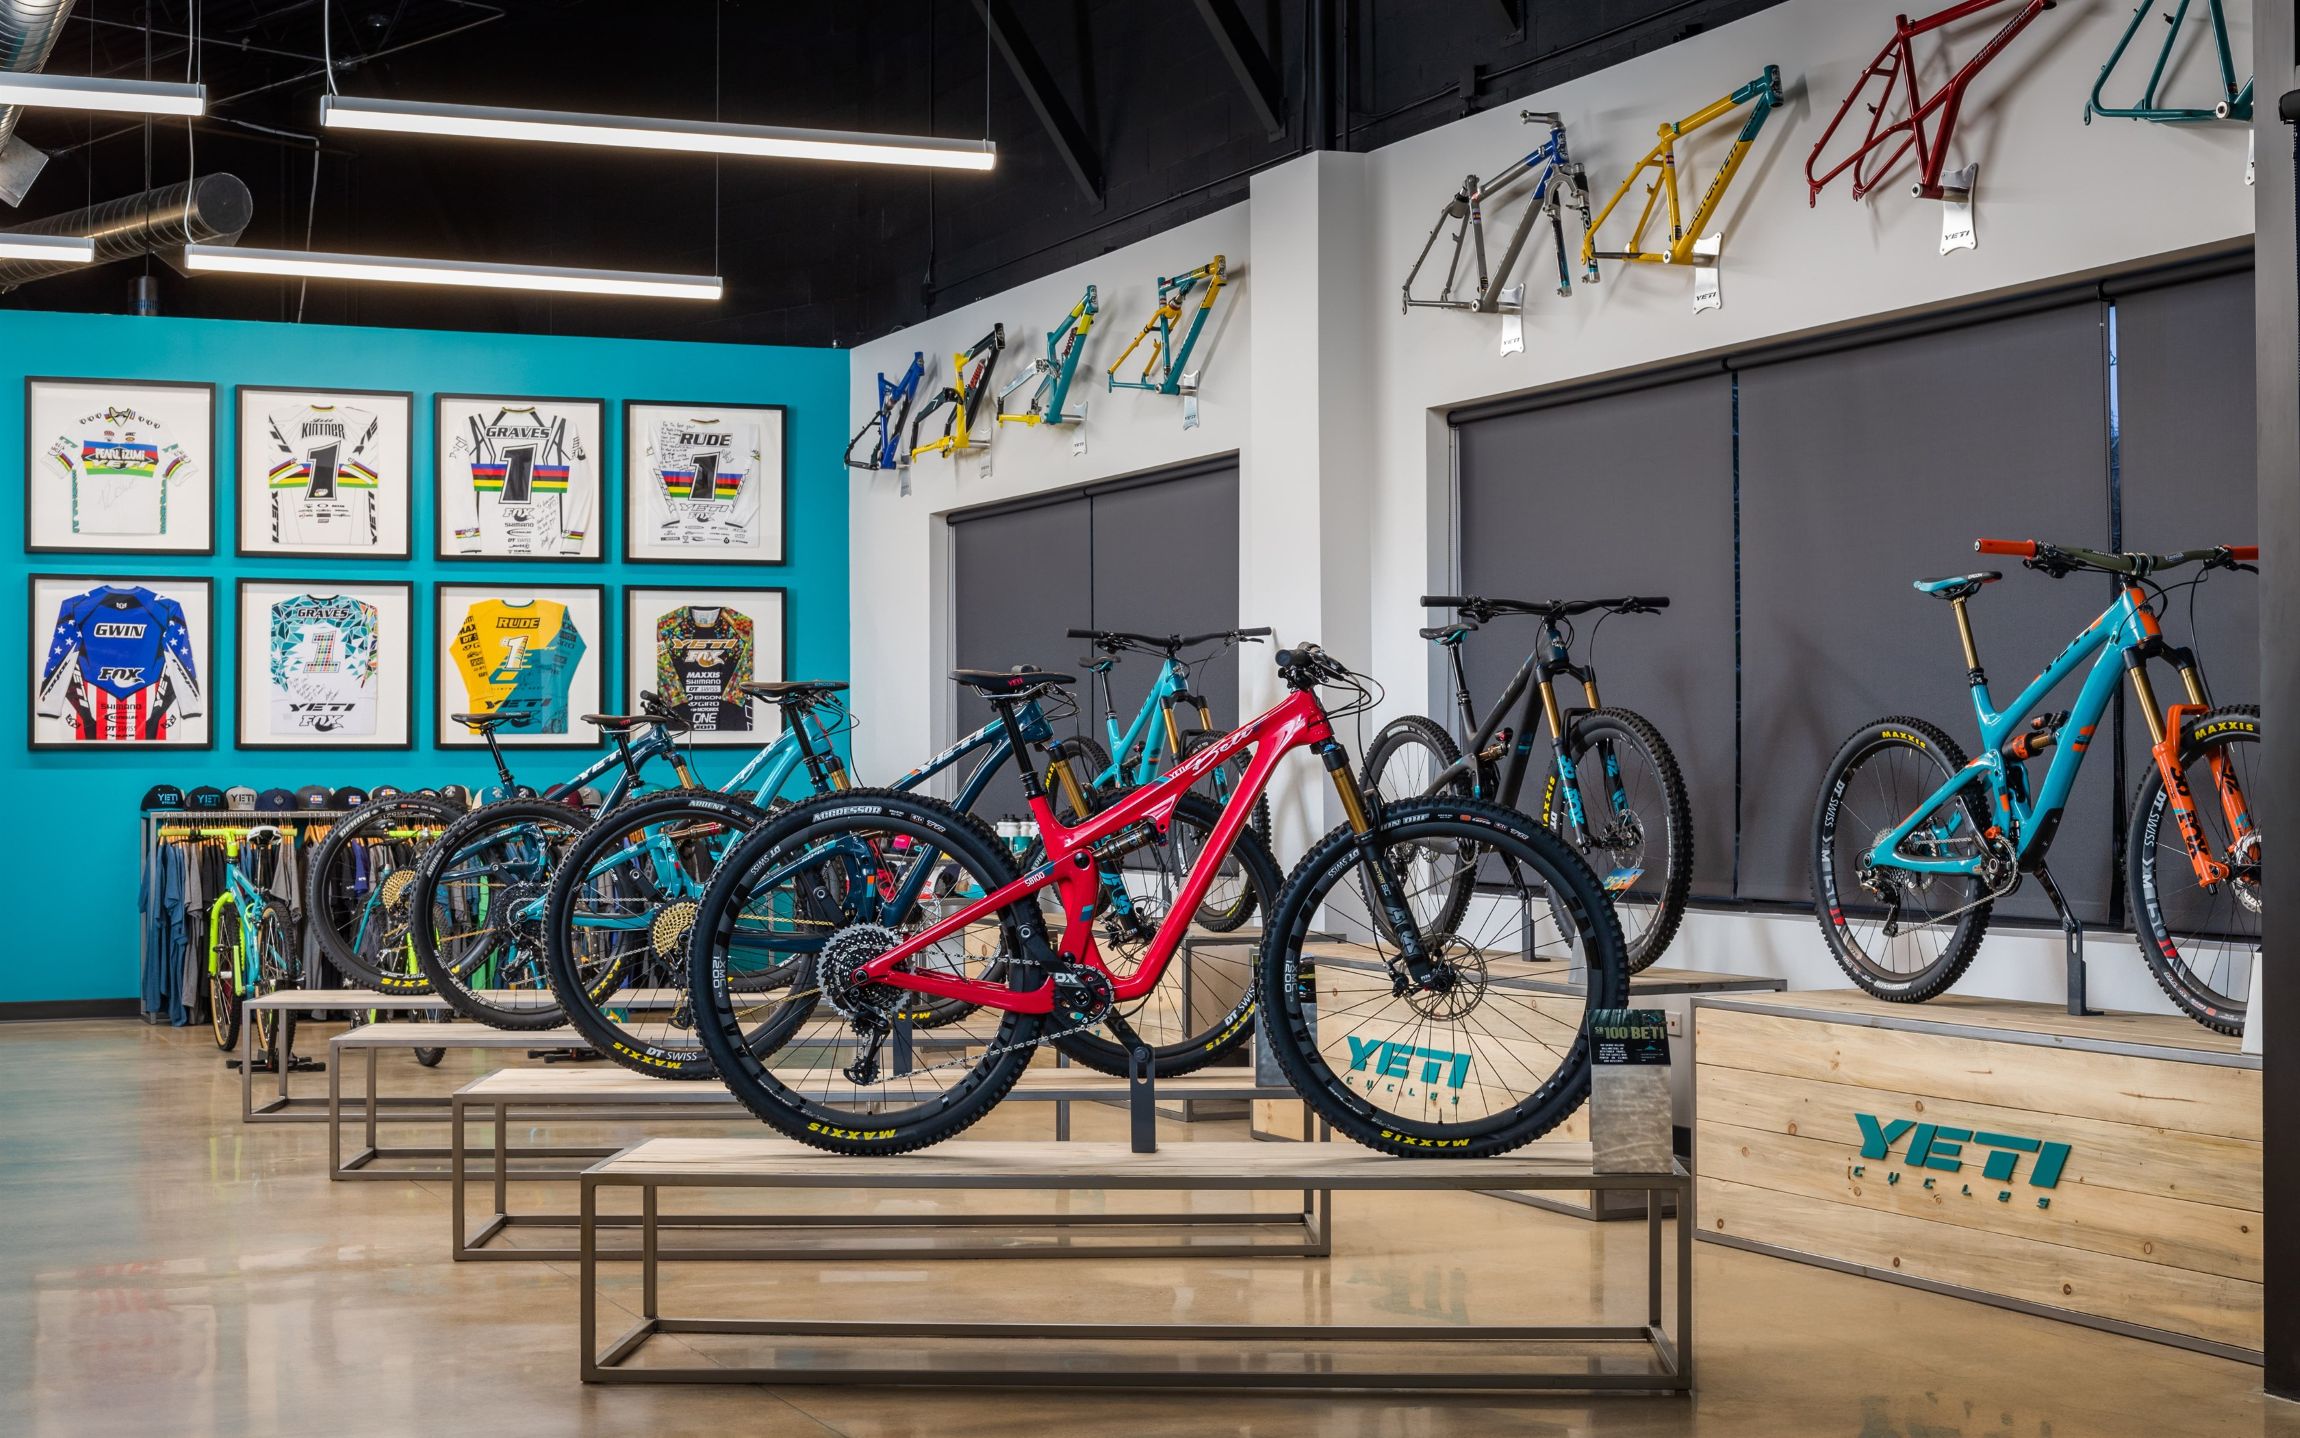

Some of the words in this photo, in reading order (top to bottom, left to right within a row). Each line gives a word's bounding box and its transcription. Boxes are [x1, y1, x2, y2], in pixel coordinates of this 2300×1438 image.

[1945, 229, 1970, 241] YETI
[1695, 290, 1718, 303] YETI
[1503, 337, 1521, 347] YETI
[485, 425, 552, 440] GRAVES
[680, 432, 734, 447] RUDE
[304, 440, 341, 501] 1
[498, 443, 538, 504] 1
[688, 451, 720, 501] 1
[503, 507, 535, 522] FOX
[688, 512, 716, 523] FOX
[297, 608, 350, 618] GRAVES
[95, 624, 146, 638] GWIN
[496, 616, 541, 629] RUDE
[672, 639, 739, 649] YETI
[503, 635, 529, 671] 1
[685, 650, 725, 667] FOX
[98, 667, 145, 688] FOX
[289, 703, 355, 712] YETI
[299, 715, 344, 732] FOX
[2194, 721, 2254, 740] MAXXIS
[1882, 730, 1926, 749] MAXXIS
[1169, 766, 1187, 779] YETI
[1835, 779, 1845, 798] DT
[157, 793, 179, 802] YETI
[196, 794, 220, 803] YETI
[230, 794, 255, 803] YETI
[2157, 790, 2167, 811] DT
[812, 805, 882, 823] AGGRESSOR
[1824, 798, 1839, 828] SWISS
[2144, 811, 2160, 846] SWISS
[769, 845, 781, 858] DT
[750, 856, 771, 875] SWISS
[1328, 858, 1348, 879] SWISS
[1025, 872, 1046, 887] SB100
[381, 977, 429, 988] XXIS
[1284, 959, 1292, 993] 1200
[1224, 1011, 1239, 1027] DT
[1631, 1026, 1665, 1040] BETI
[613, 1042, 683, 1069] MAXXIS
[646, 1046, 665, 1057] DT
[666, 1051, 698, 1061] SWISS
[1347, 1035, 1472, 1089] YETI
[807, 1121, 896, 1140] MAXXIS
[1380, 1129, 1470, 1148] MAXXIS
[1854, 1112, 2073, 1189] YETI
[1853, 1165, 2051, 1210] CYCLES
